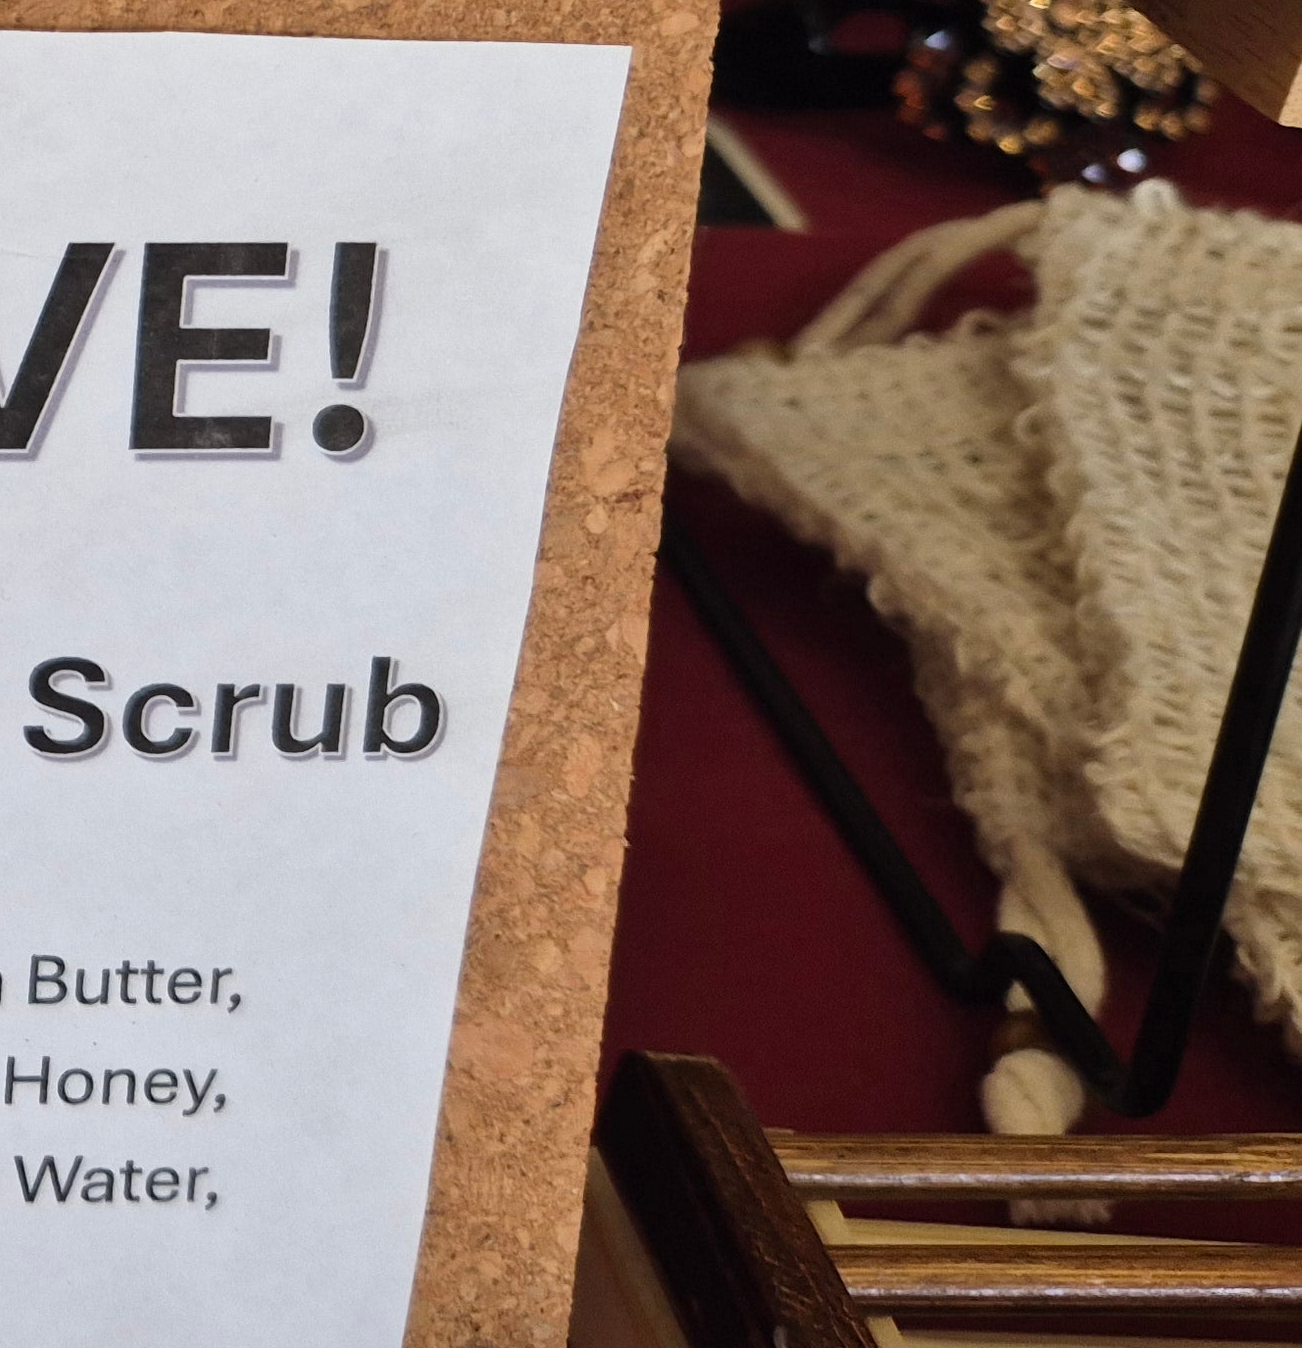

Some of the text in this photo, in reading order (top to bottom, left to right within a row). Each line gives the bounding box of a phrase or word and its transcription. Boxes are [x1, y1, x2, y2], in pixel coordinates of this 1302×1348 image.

[24, 657, 446, 760] Scrub
[26, 952, 244, 1015] Butter,
[3, 1054, 228, 1119] Honey,
[12, 1154, 219, 1213] Water,
